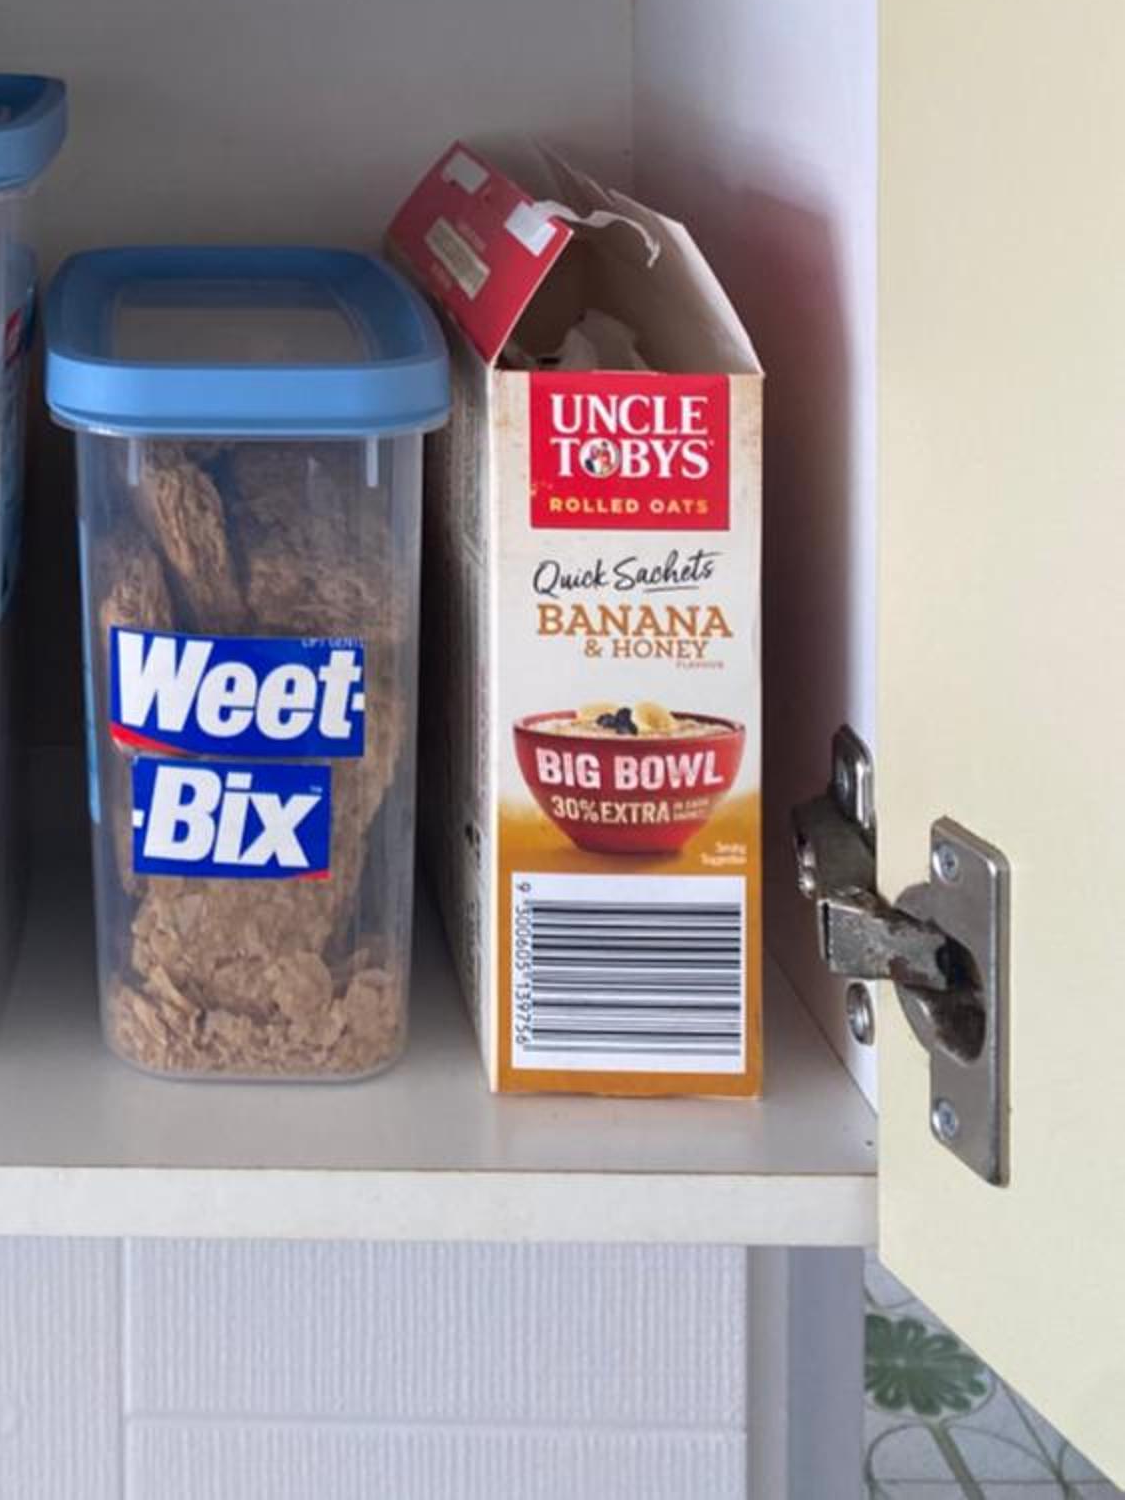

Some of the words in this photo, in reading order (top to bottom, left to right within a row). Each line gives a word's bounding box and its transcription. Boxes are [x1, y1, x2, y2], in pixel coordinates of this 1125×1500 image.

[550, 394, 709, 434] UNCLE
[550, 439, 712, 480] TOBYS
[549, 498, 640, 514] ROLLED
[650, 498, 709, 514] OATS
[532, 559, 610, 600] Quick
[613, 548, 723, 591] Sachets
[536, 603, 734, 637] BANANA
[583, 640, 603, 658] &
[612, 639, 710, 659] HONEY
[535, 747, 601, 790] BIG
[613, 750, 724, 791] BOWL
[551, 794, 599, 822] 30%
[600, 800, 670, 824] EXTRA
